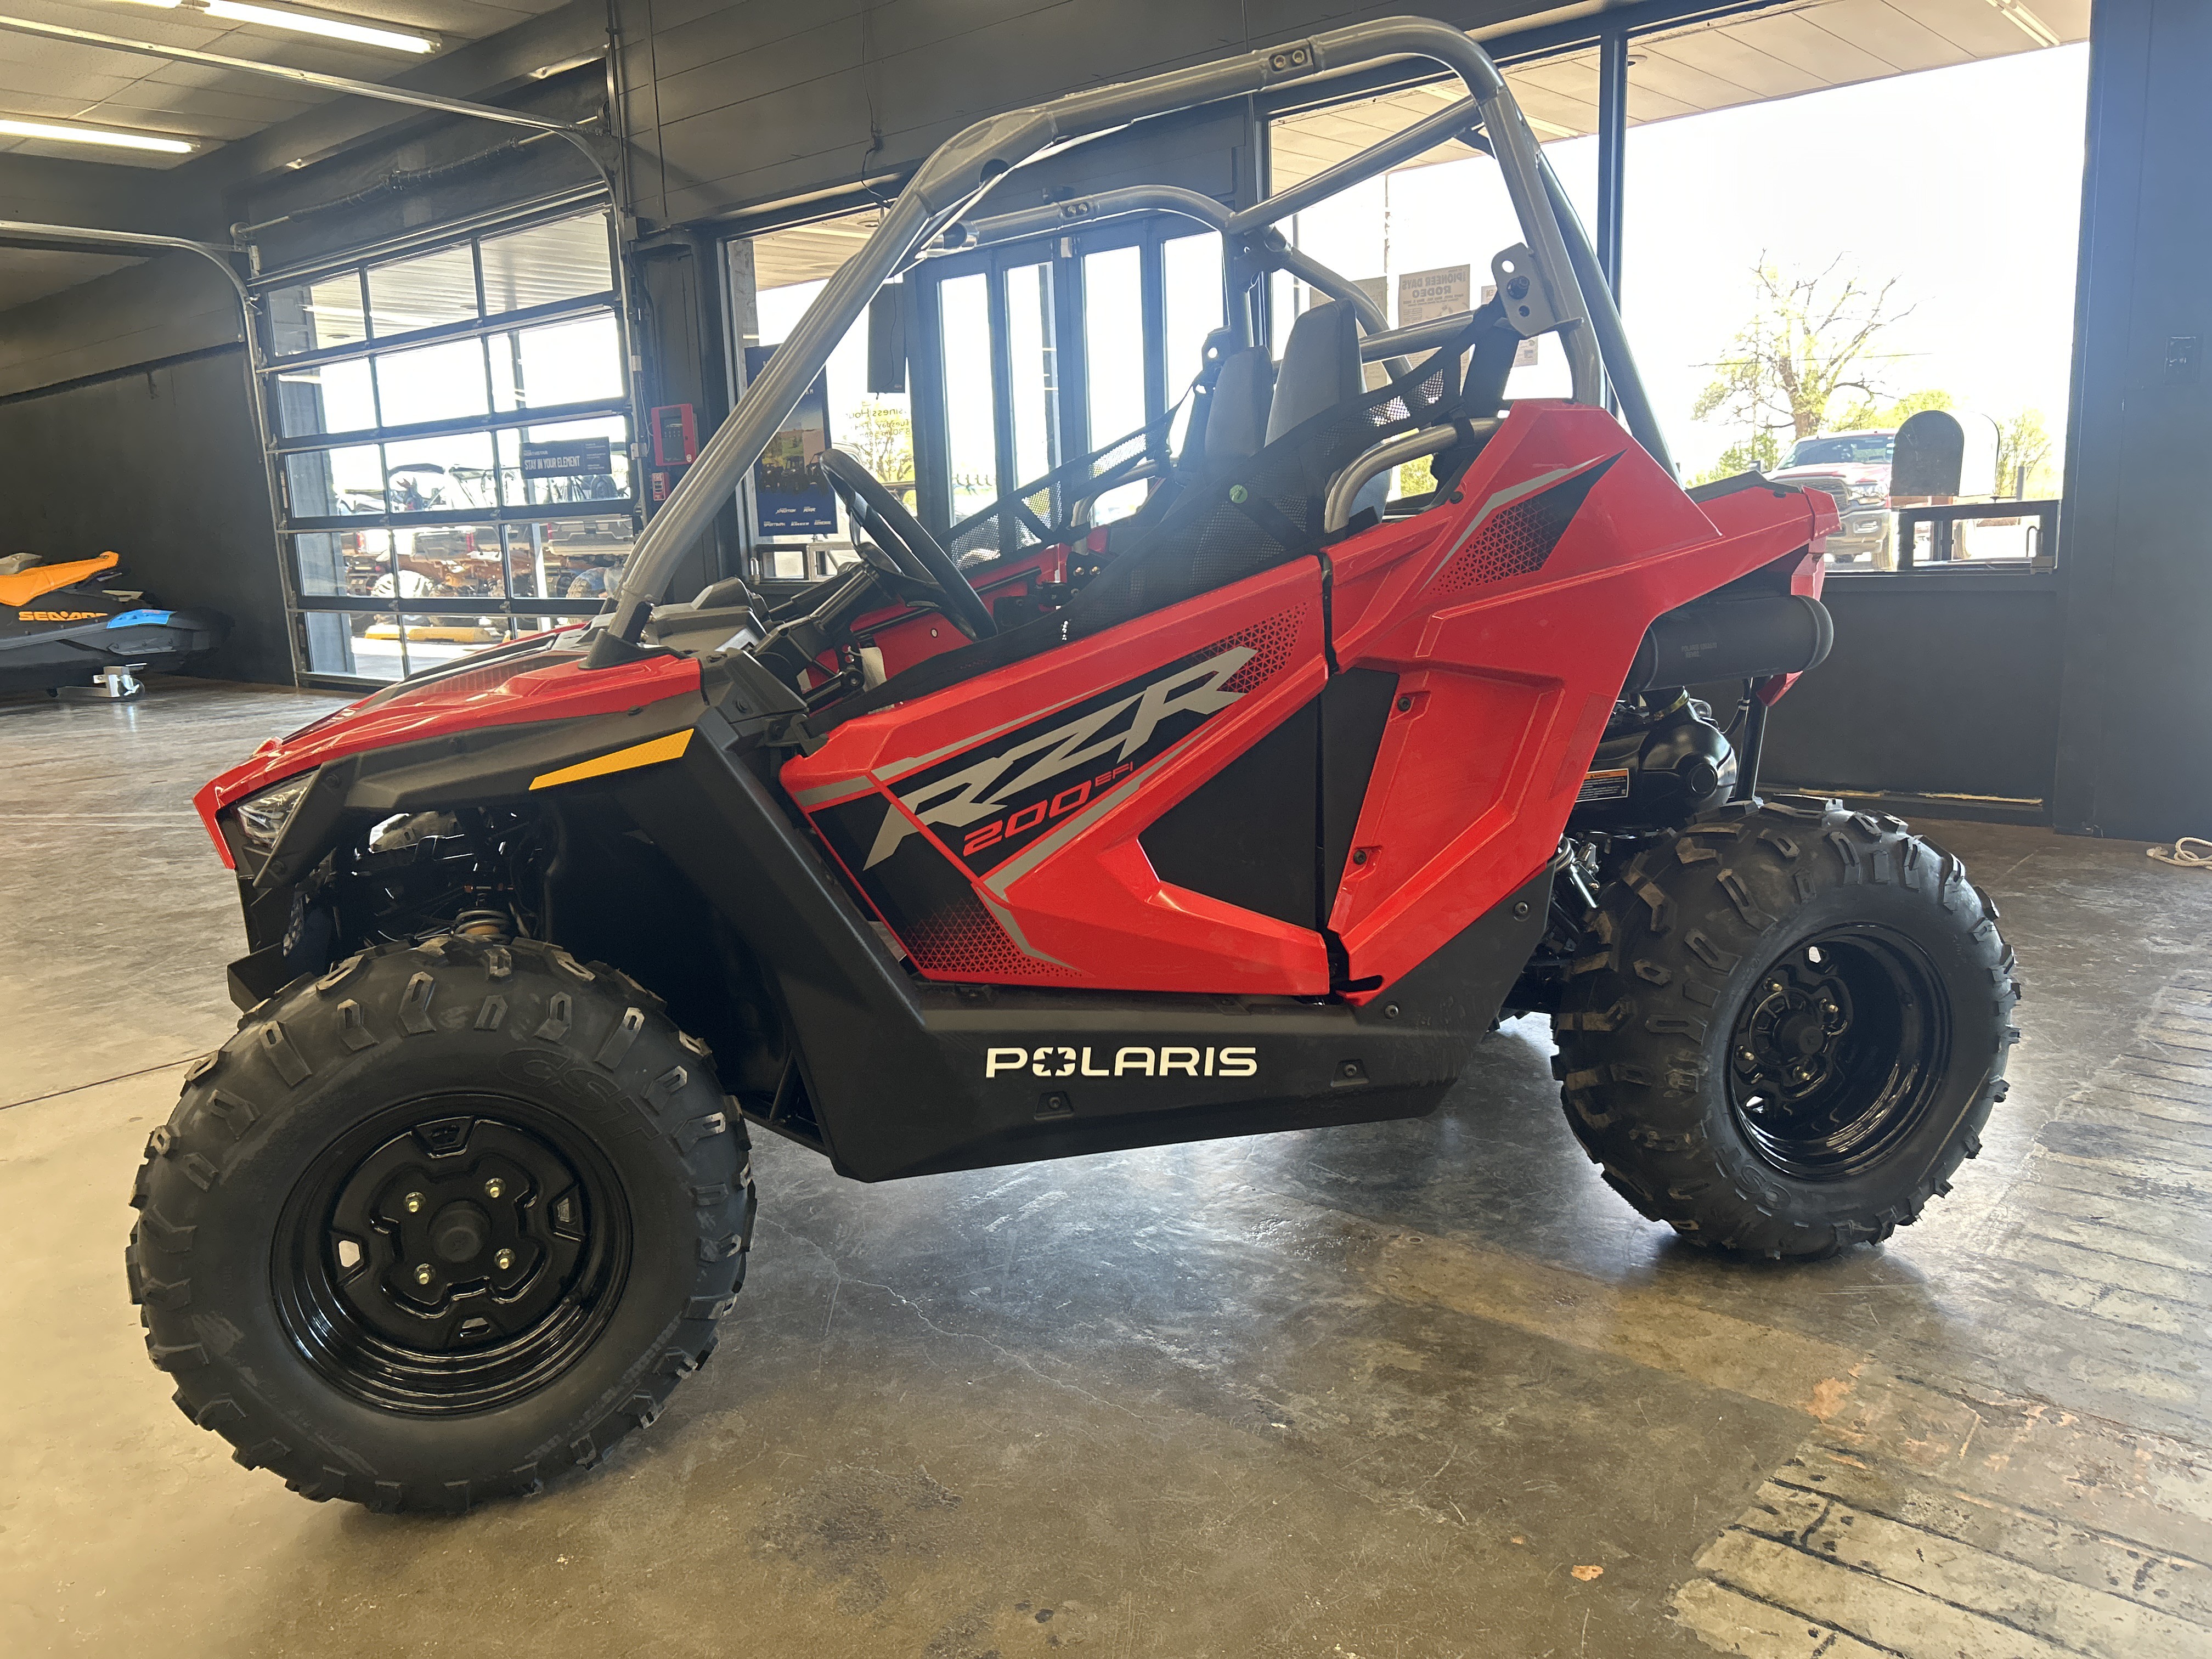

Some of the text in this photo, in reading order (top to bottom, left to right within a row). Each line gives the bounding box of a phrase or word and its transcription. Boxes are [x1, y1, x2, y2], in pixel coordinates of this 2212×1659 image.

[524, 456, 580, 470] STAY IN YOUR ELEMENT
[863, 646, 1259, 871] RZR
[963, 761, 1135, 856] 200 EFI
[496, 1047, 662, 1141] CST
[986, 1046, 1257, 1079] POLARIS
